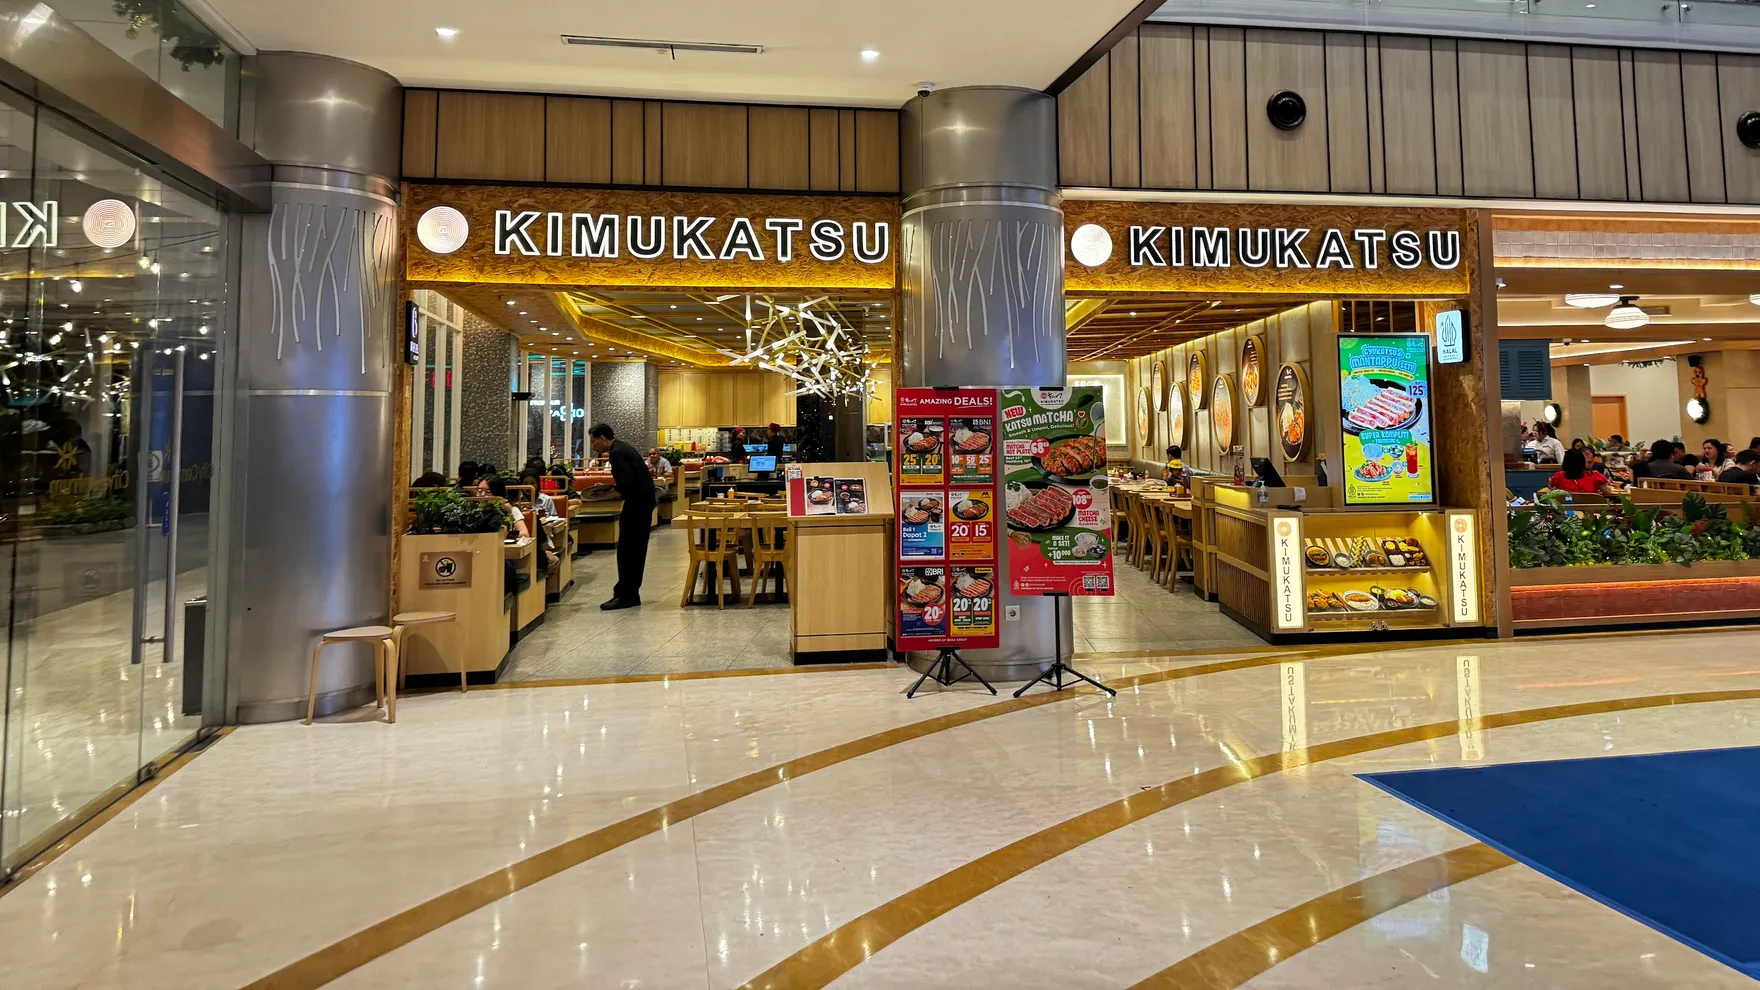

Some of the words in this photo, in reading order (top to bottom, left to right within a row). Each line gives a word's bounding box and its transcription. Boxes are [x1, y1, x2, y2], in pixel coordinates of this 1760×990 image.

[494, 210, 890, 263] KIMUKATSU
[1128, 225, 1461, 270] KIMUKATSU
[1364, 348, 1398, 356] GYUKATSU
[1351, 356, 1400, 368] MANTAPPU
[1409, 385, 1424, 396] 125
[954, 397, 993, 406] DEALS!
[1004, 406, 1024, 419] NEW
[1005, 416, 1032, 433] KATSU
[1033, 410, 1074, 425] MATCHA
[1361, 431, 1381, 440] SUPER
[932, 567, 944, 576] BRI
[1457, 535, 1468, 616] KIMUKATSU
[1281, 538, 1292, 622] KIMUKATSU
